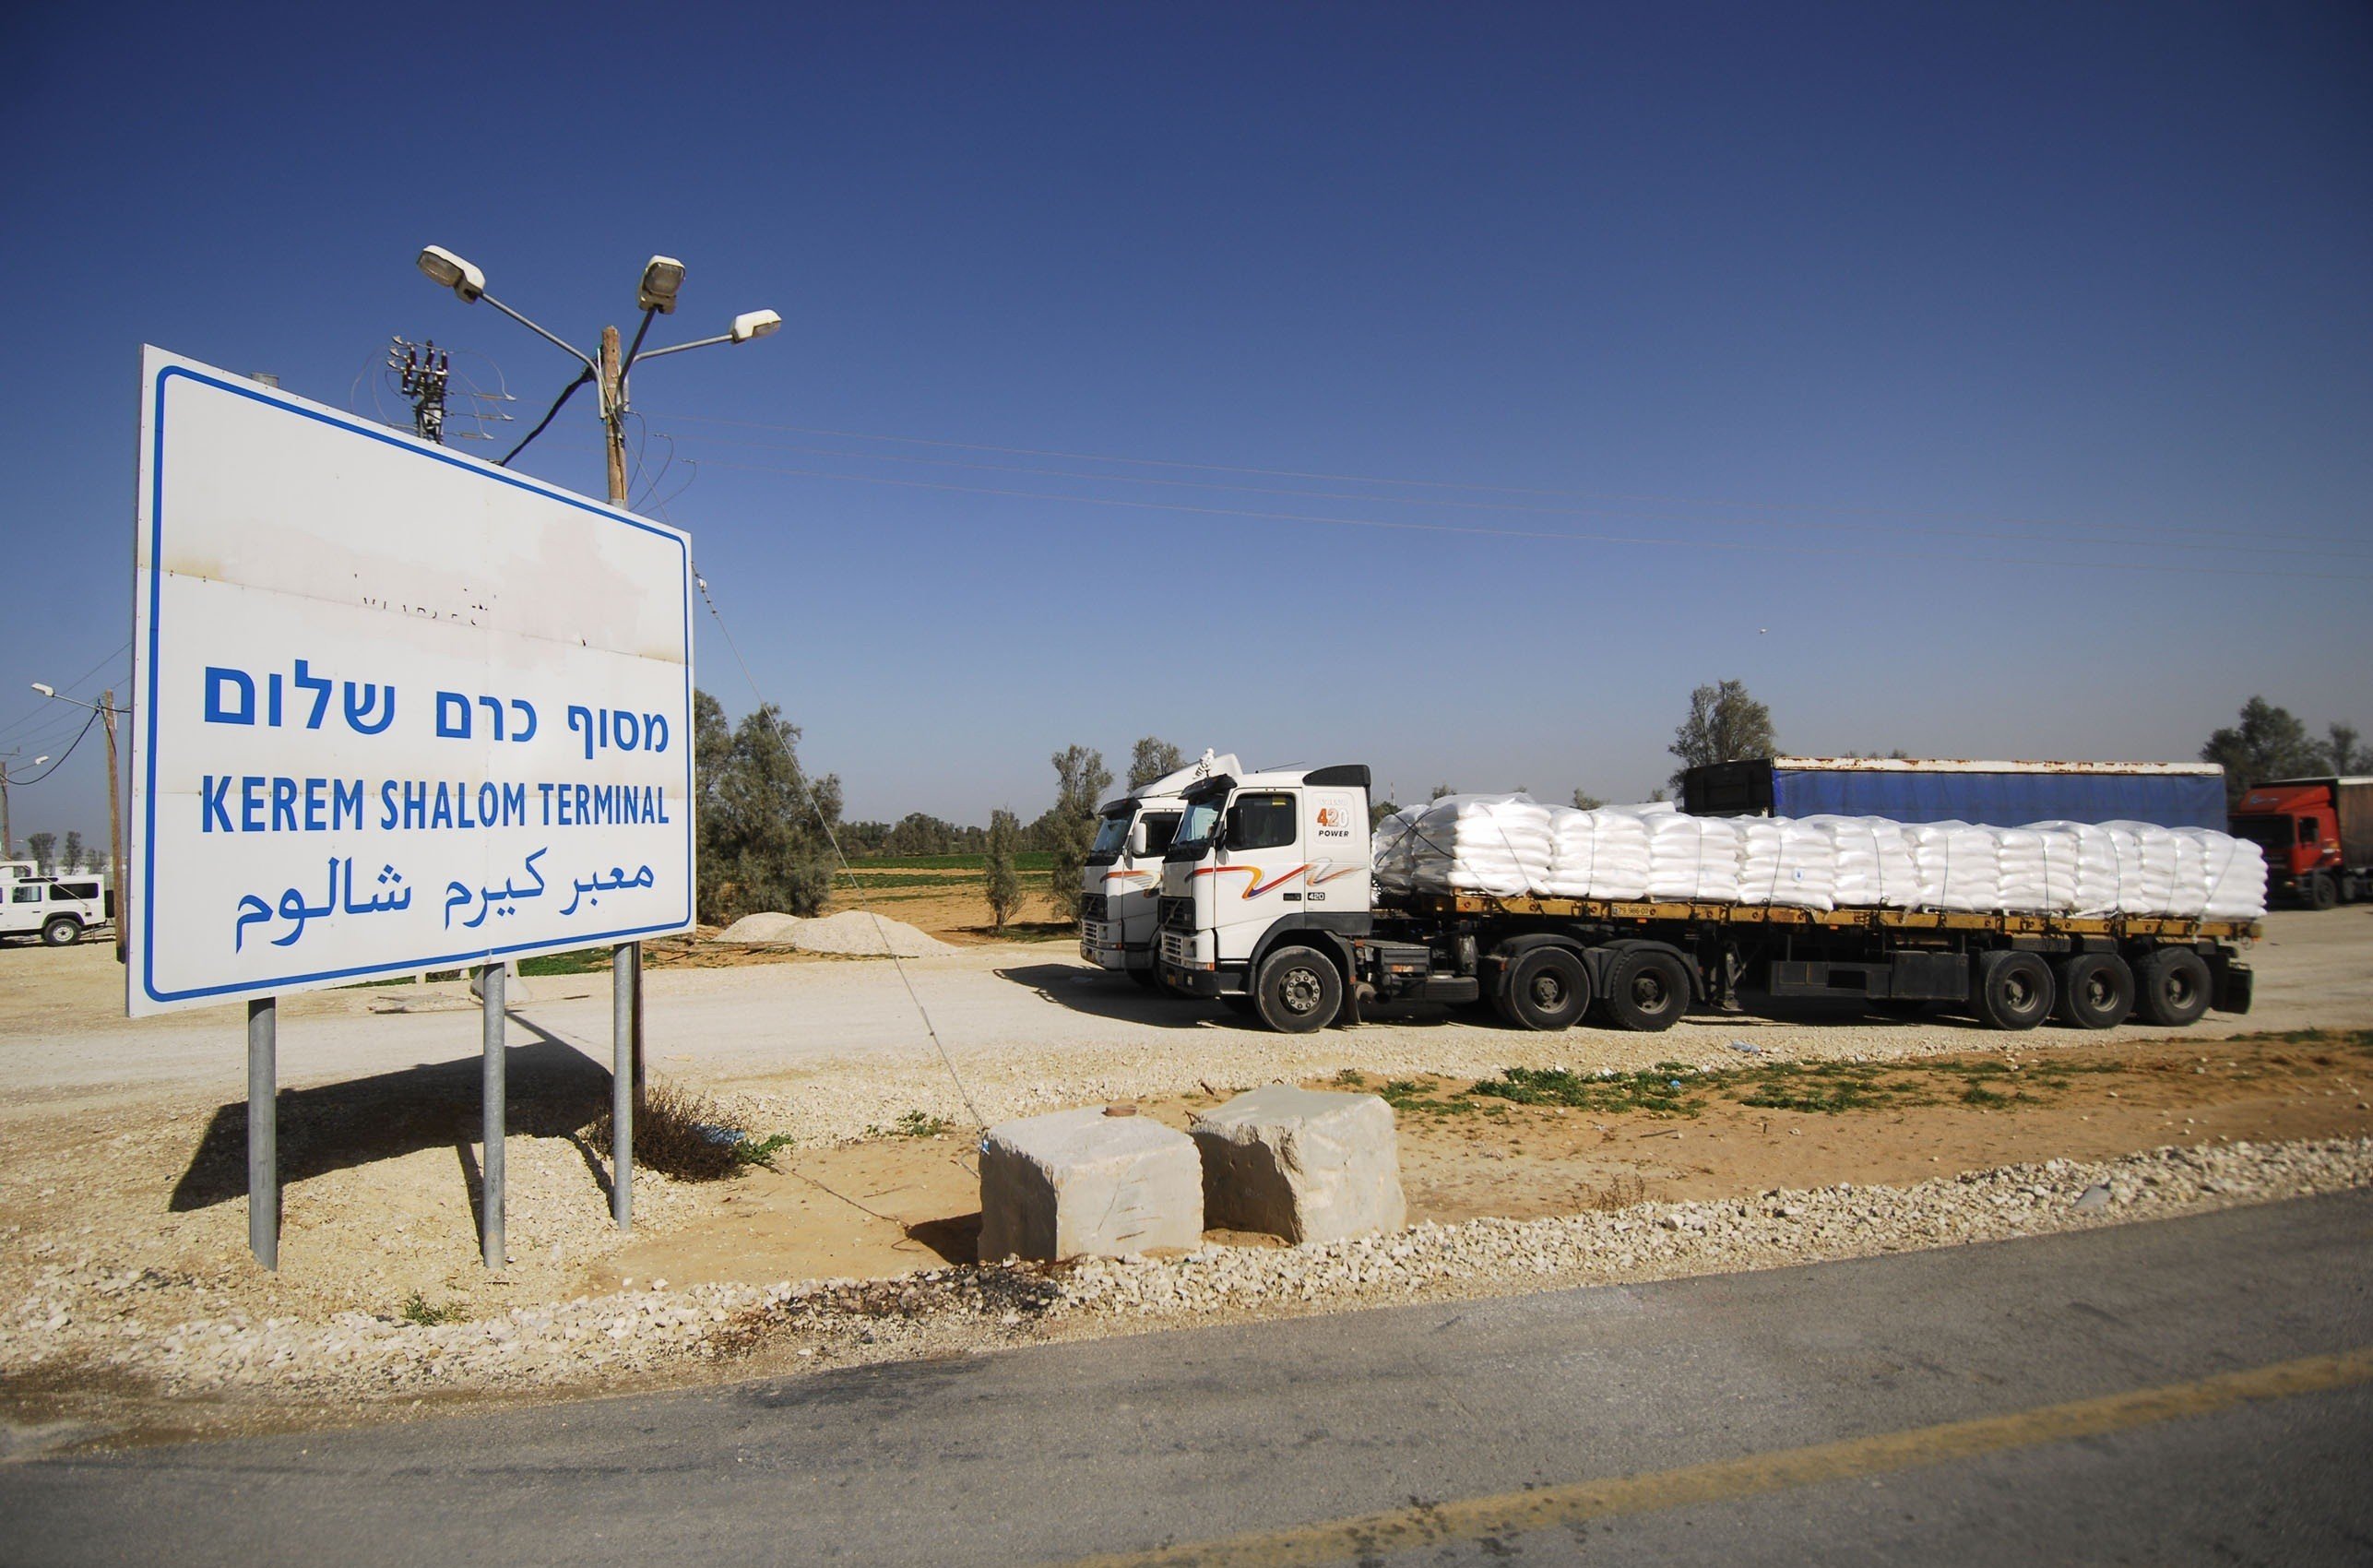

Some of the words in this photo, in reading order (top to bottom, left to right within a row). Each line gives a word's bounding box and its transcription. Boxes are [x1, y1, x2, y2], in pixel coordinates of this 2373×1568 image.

[204, 659, 395, 735] שלום
[436, 692, 538, 742] כרם
[568, 706, 669, 760] מסוף
[203, 776, 364, 833] KEREM
[381, 780, 525, 830] SHALOM
[540, 784, 670, 826] TERMINAL
[1317, 808, 1349, 827] 420
[236, 857, 412, 954] شالوم
[445, 847, 548, 930] كيرم
[560, 866, 655, 916] معبر
